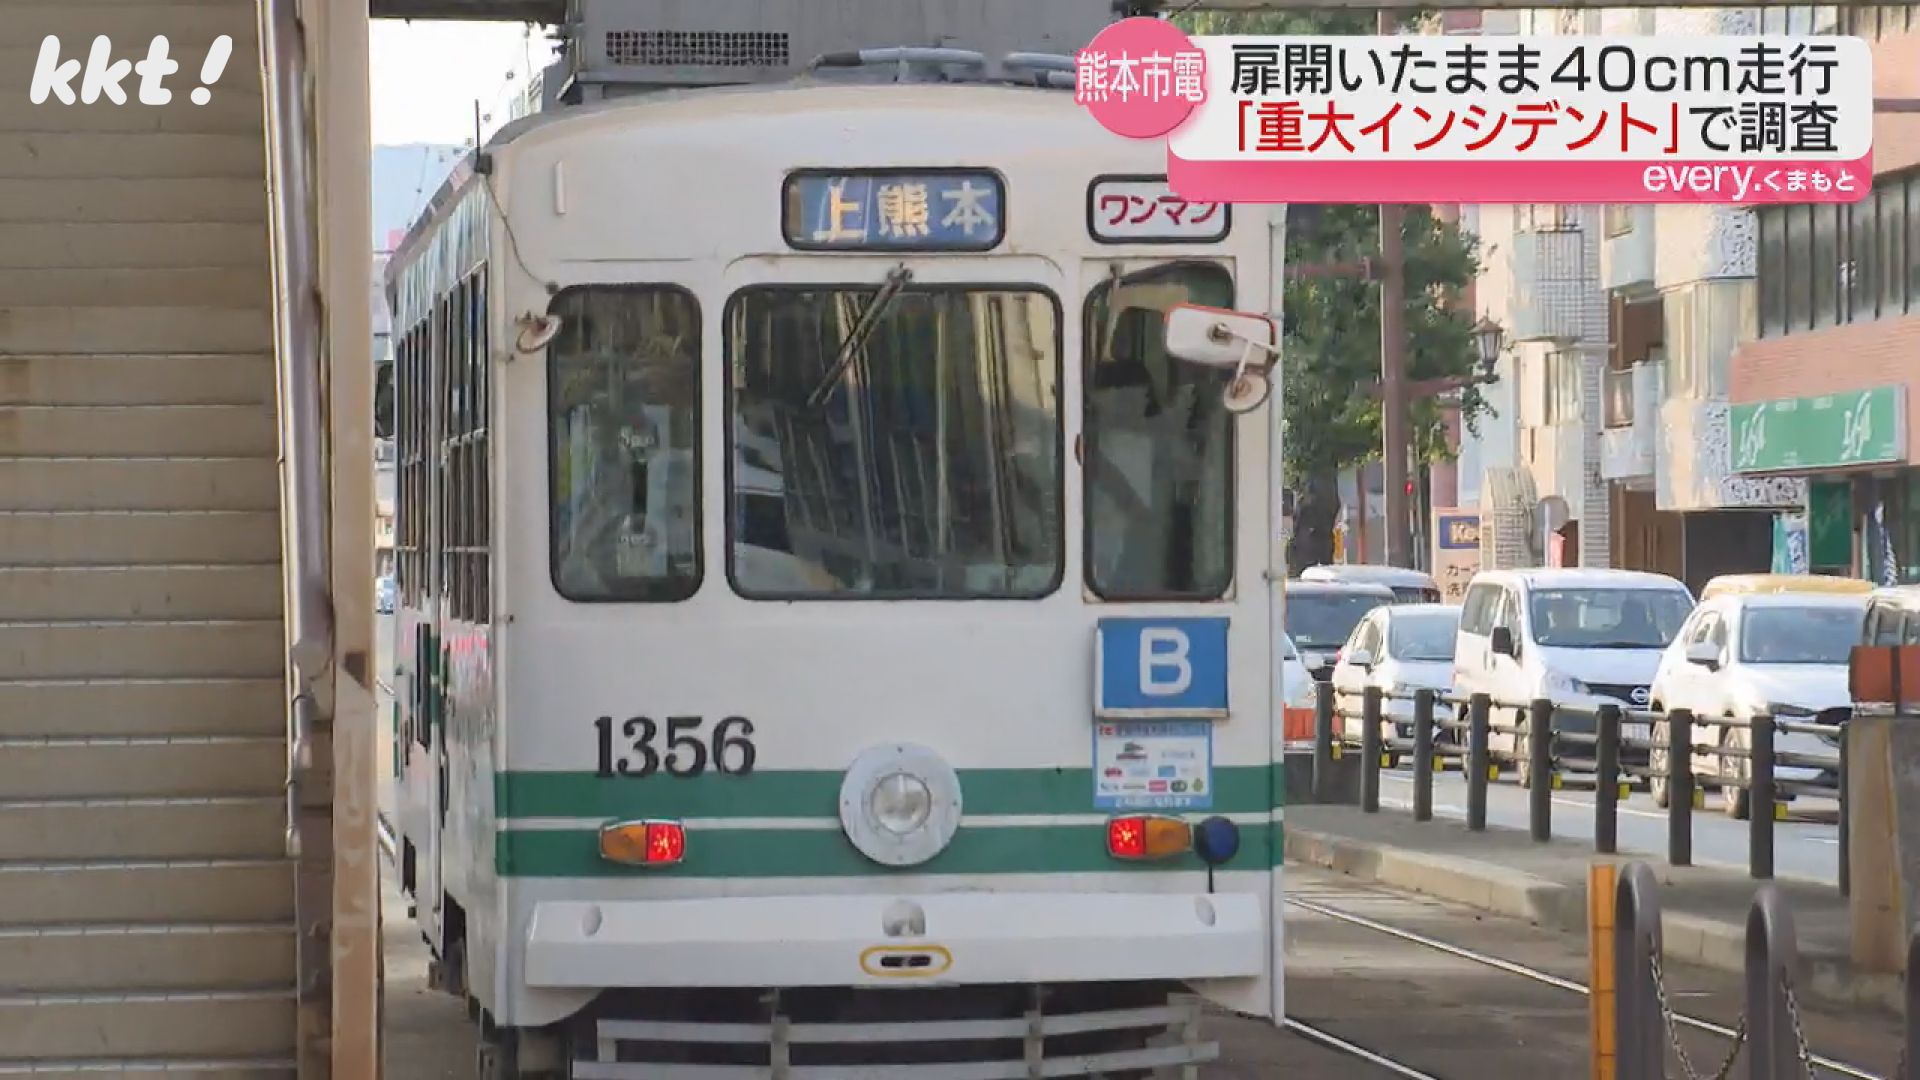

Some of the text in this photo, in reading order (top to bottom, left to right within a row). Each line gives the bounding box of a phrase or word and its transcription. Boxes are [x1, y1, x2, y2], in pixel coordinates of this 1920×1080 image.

[813, 179, 995, 242] 上熊本
[1139, 626, 1192, 695] B
[594, 715, 756, 778] 1356
